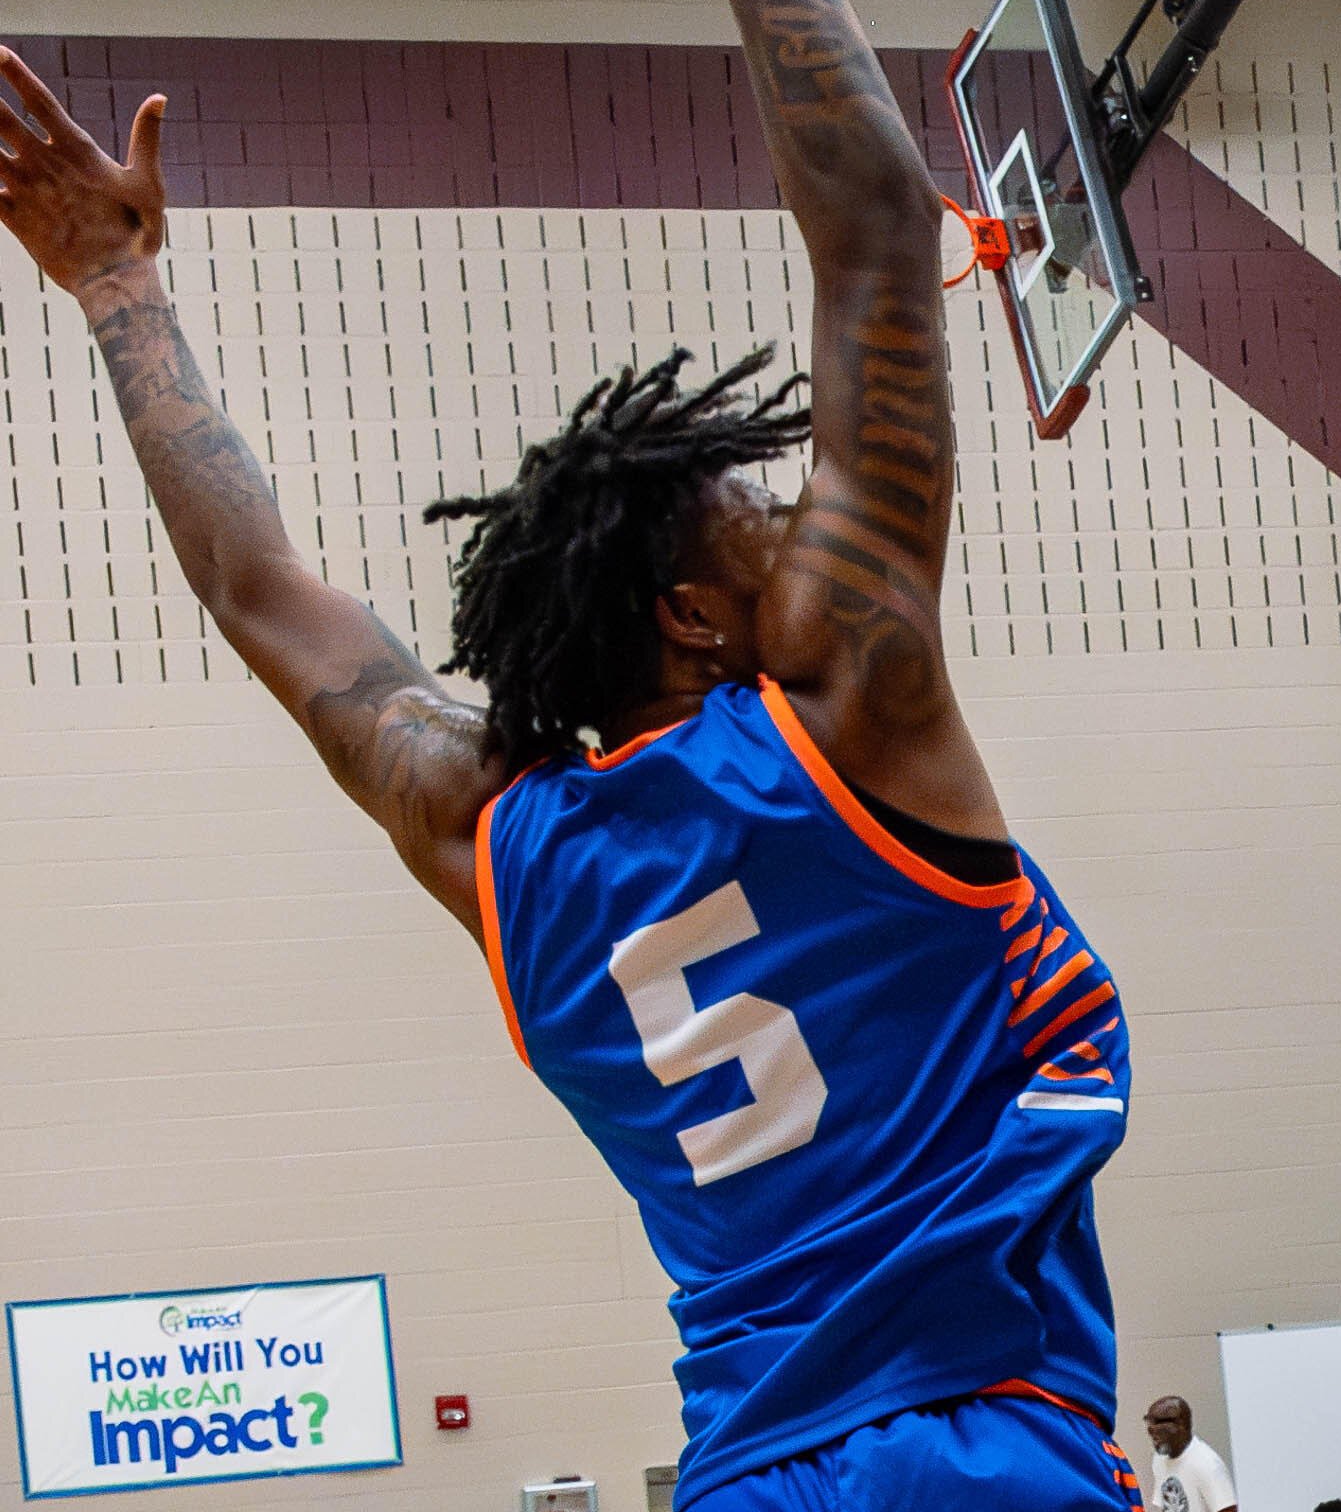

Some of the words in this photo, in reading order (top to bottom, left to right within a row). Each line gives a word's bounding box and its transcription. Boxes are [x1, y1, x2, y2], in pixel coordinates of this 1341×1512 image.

[608, 879, 829, 1187] 5
[89, 1349, 167, 1384] How
[180, 1340, 244, 1375] Will
[255, 1335, 325, 1369] You
